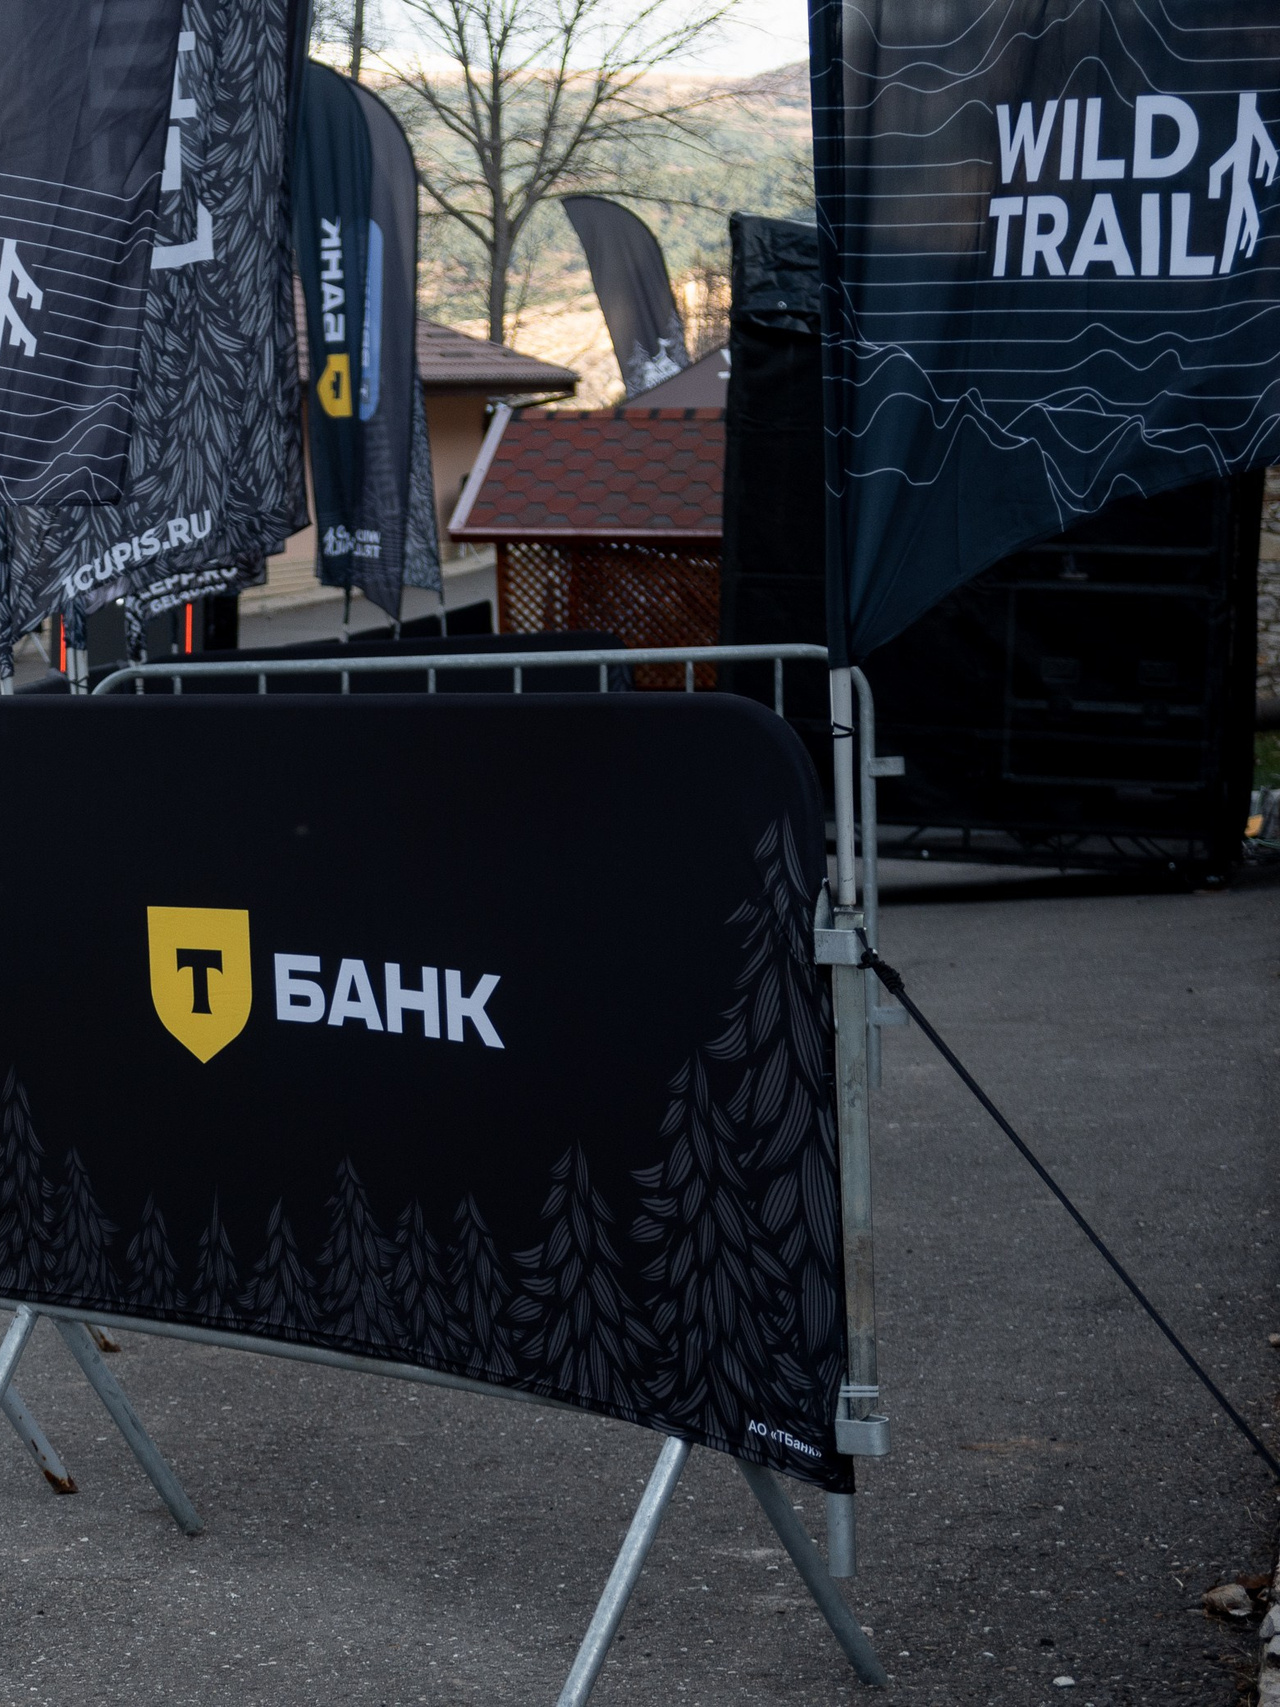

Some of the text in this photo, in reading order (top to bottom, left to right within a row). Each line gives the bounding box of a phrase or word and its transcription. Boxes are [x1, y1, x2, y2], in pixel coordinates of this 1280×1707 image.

[996, 95, 1200, 184] WILD
[988, 192, 1216, 277] TRAIL
[62, 509, 213, 598] 1CUPIS.RU
[274, 952, 506, 1050] БАНК
[748, 1419, 822, 1458] АО «ТБанк»
